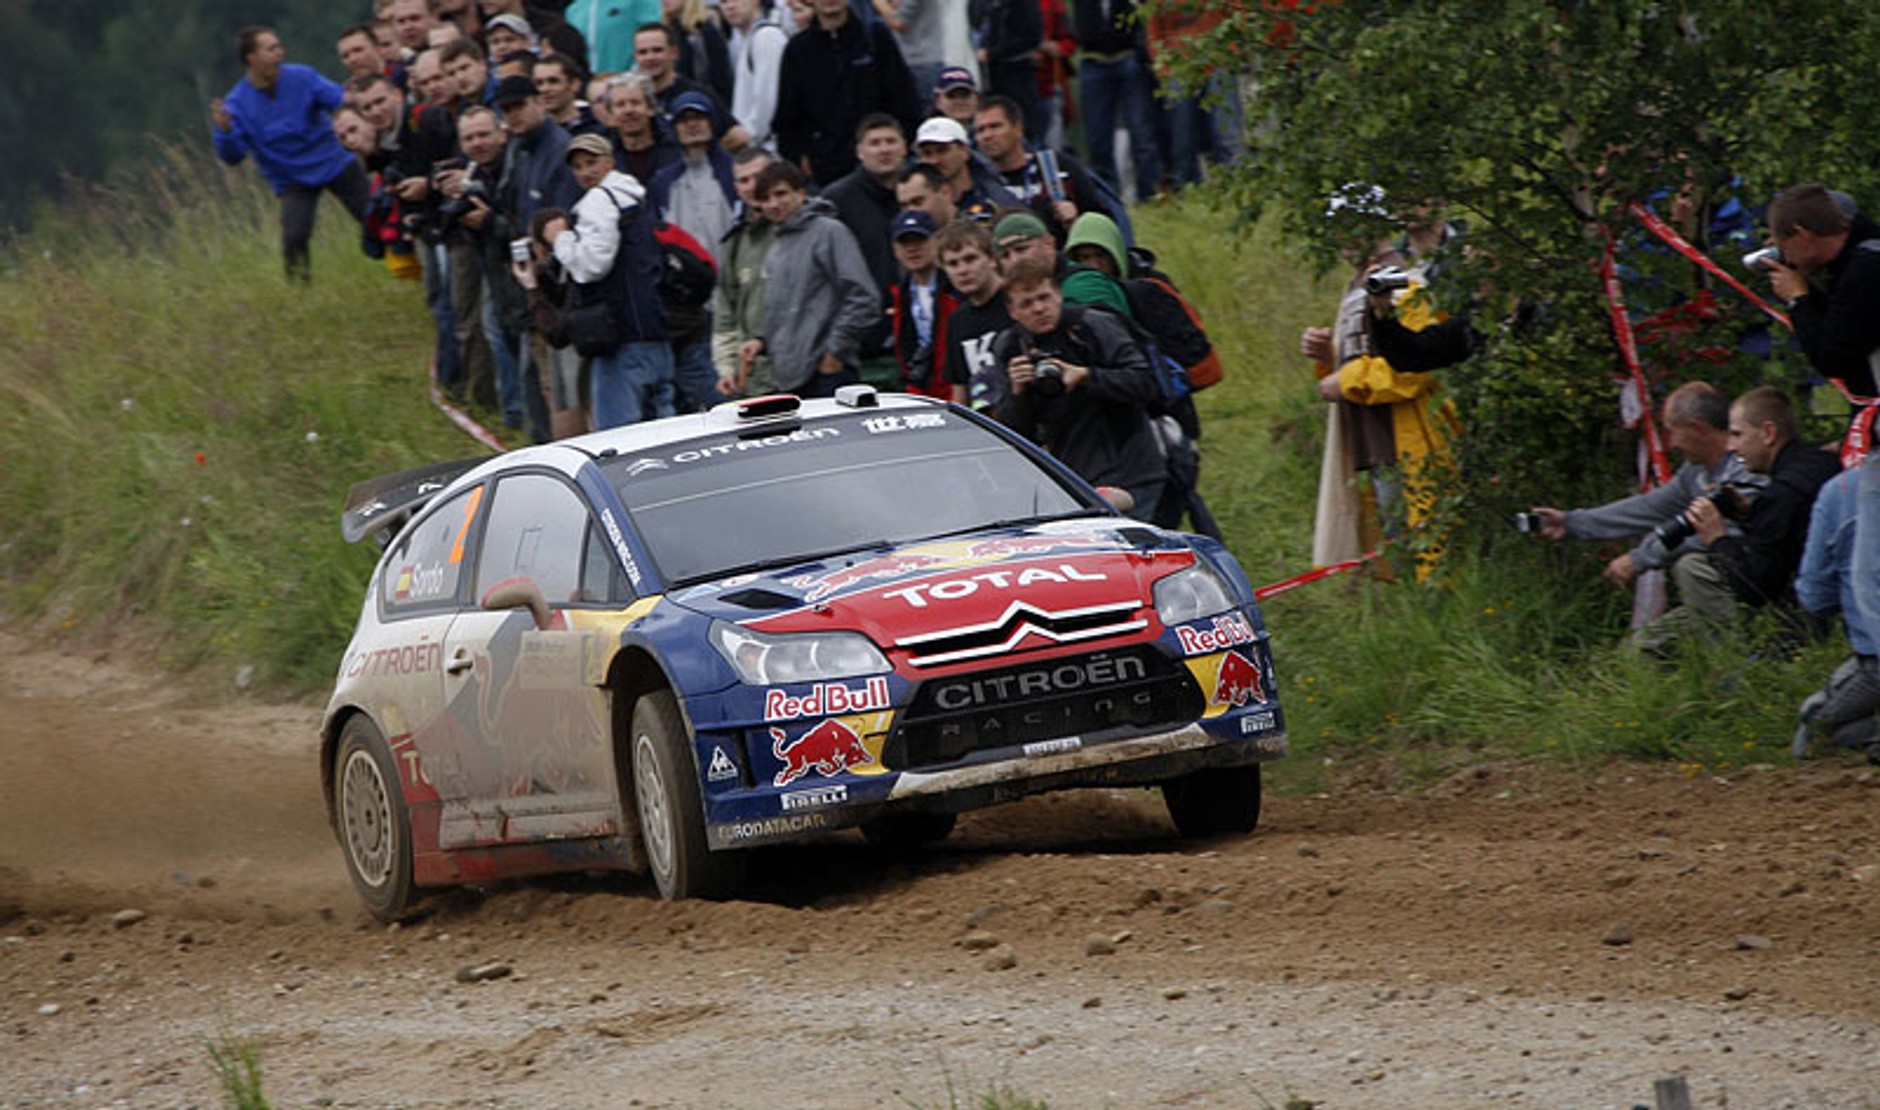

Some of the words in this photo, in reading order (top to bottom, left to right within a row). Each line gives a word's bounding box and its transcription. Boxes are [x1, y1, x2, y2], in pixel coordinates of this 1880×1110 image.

[883, 564, 1108, 608] TOTAL
[765, 685, 822, 720] Red
[826, 677, 889, 714] Bull
[935, 653, 1146, 710] CITROËN
[941, 691, 1152, 736] RACING
[780, 785, 848, 810] PIRELLI
[717, 813, 827, 840] EURODATACAR
